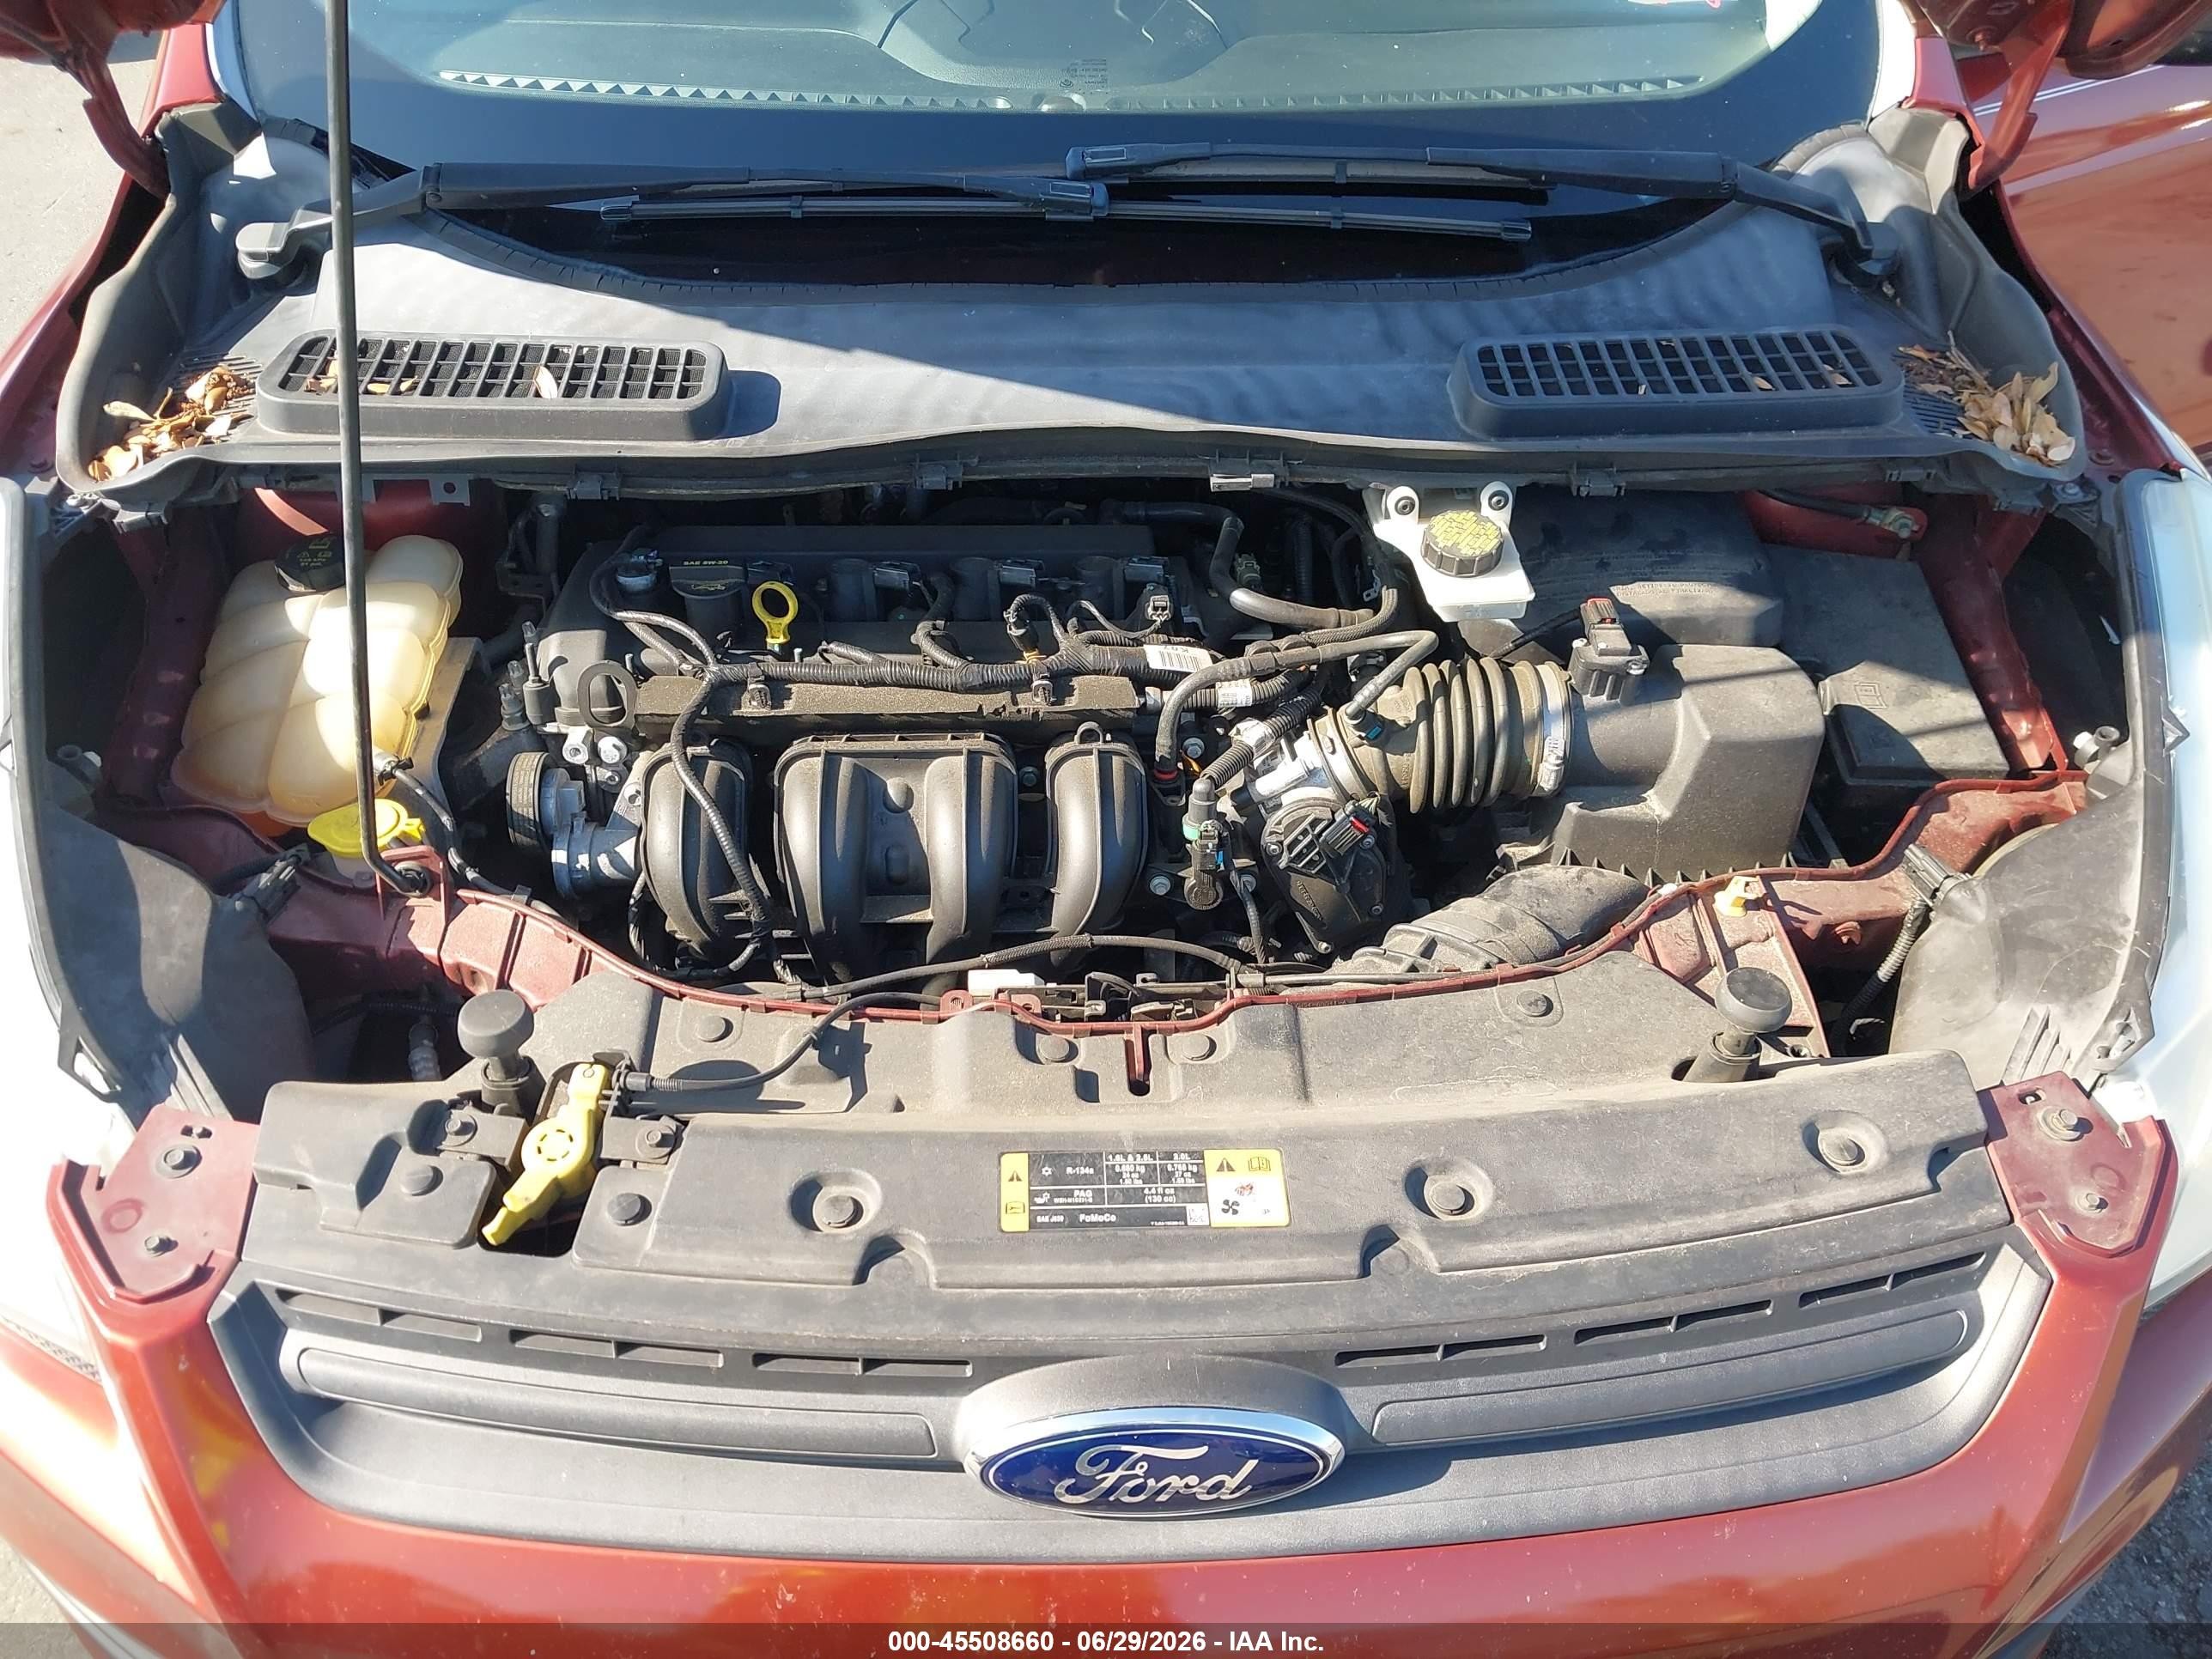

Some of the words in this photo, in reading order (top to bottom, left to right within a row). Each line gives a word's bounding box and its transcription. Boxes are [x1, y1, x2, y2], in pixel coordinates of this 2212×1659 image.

[1066, 1166, 1094, 1175] R-134a
[1073, 1189, 1093, 1198] PAG
[1143, 1187, 1156, 1195] 4.4
[1145, 1194, 1162, 1204] (130
[1079, 1213, 1117, 1223] FoMoCo
[1054, 1443, 1259, 1505] Ford
